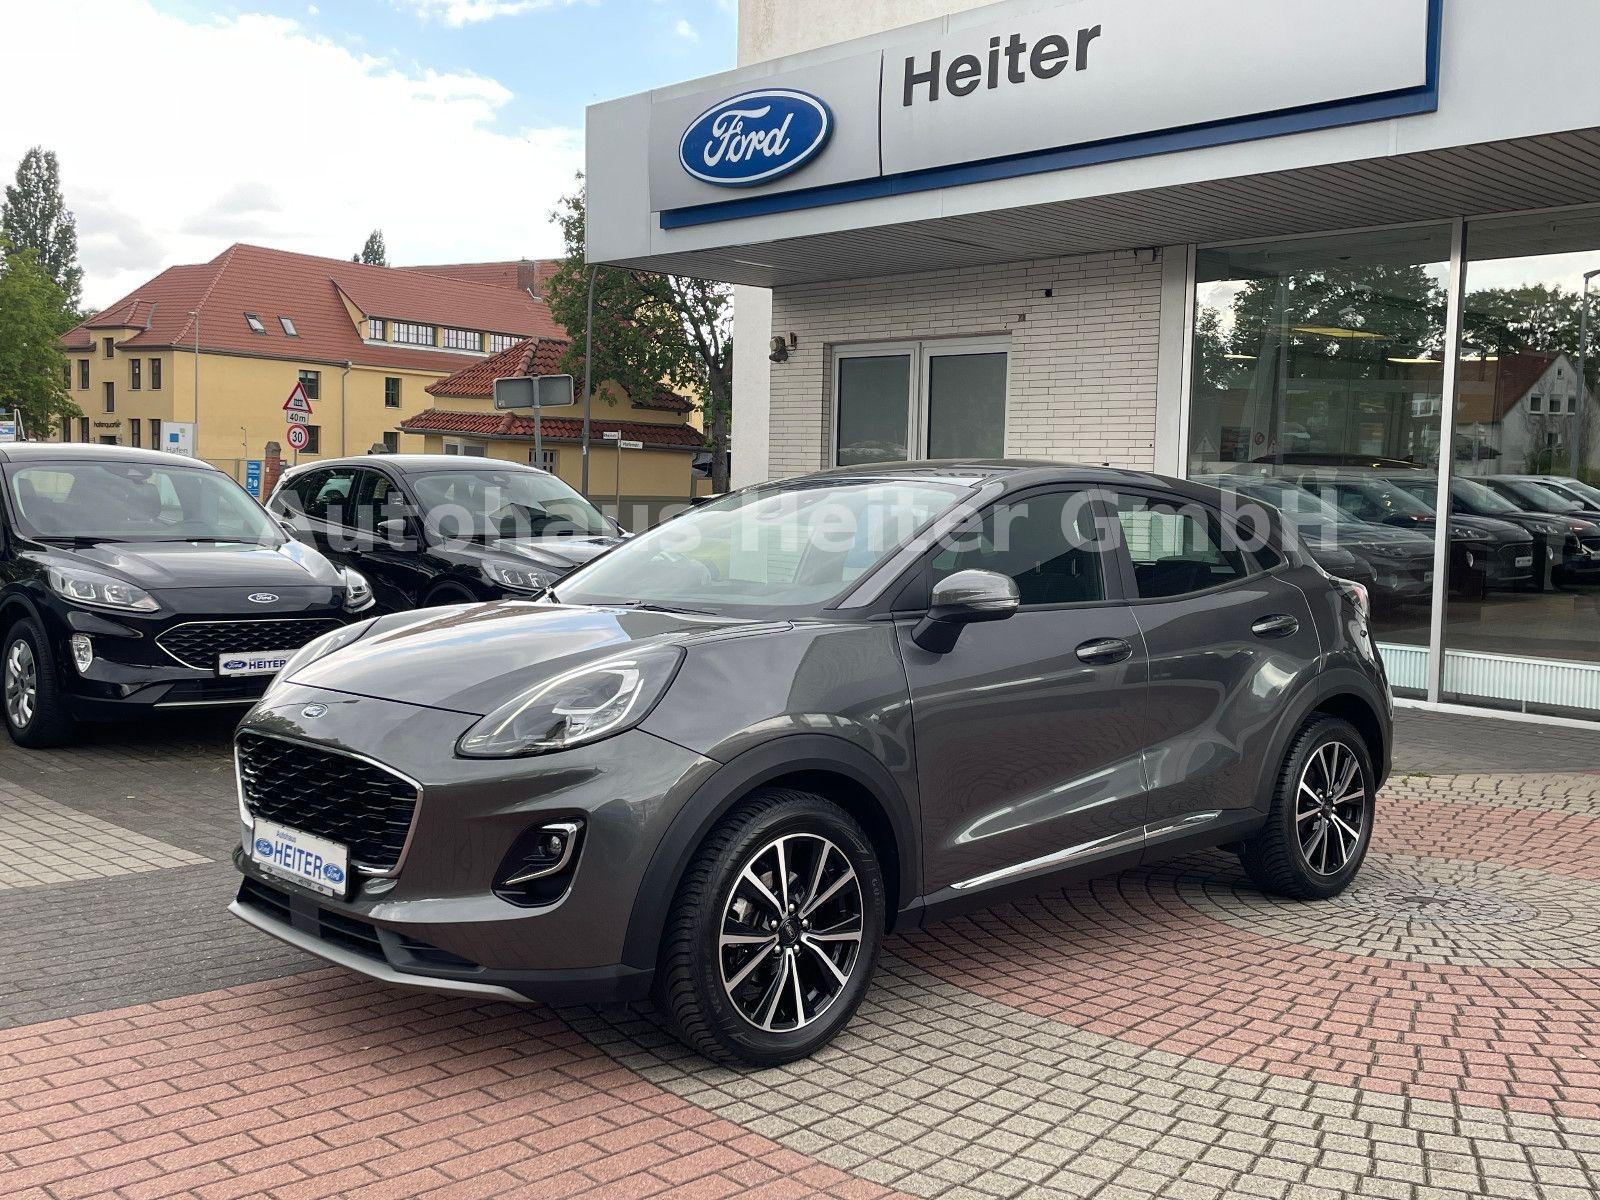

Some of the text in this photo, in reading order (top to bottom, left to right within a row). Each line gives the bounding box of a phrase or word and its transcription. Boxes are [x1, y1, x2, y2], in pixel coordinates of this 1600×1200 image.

[903, 24, 1102, 107] Heiter
[703, 105, 794, 166] Ford
[165, 446, 189, 455] Hafen
[292, 431, 303, 443] 30
[273, 840, 324, 880] HEITER
